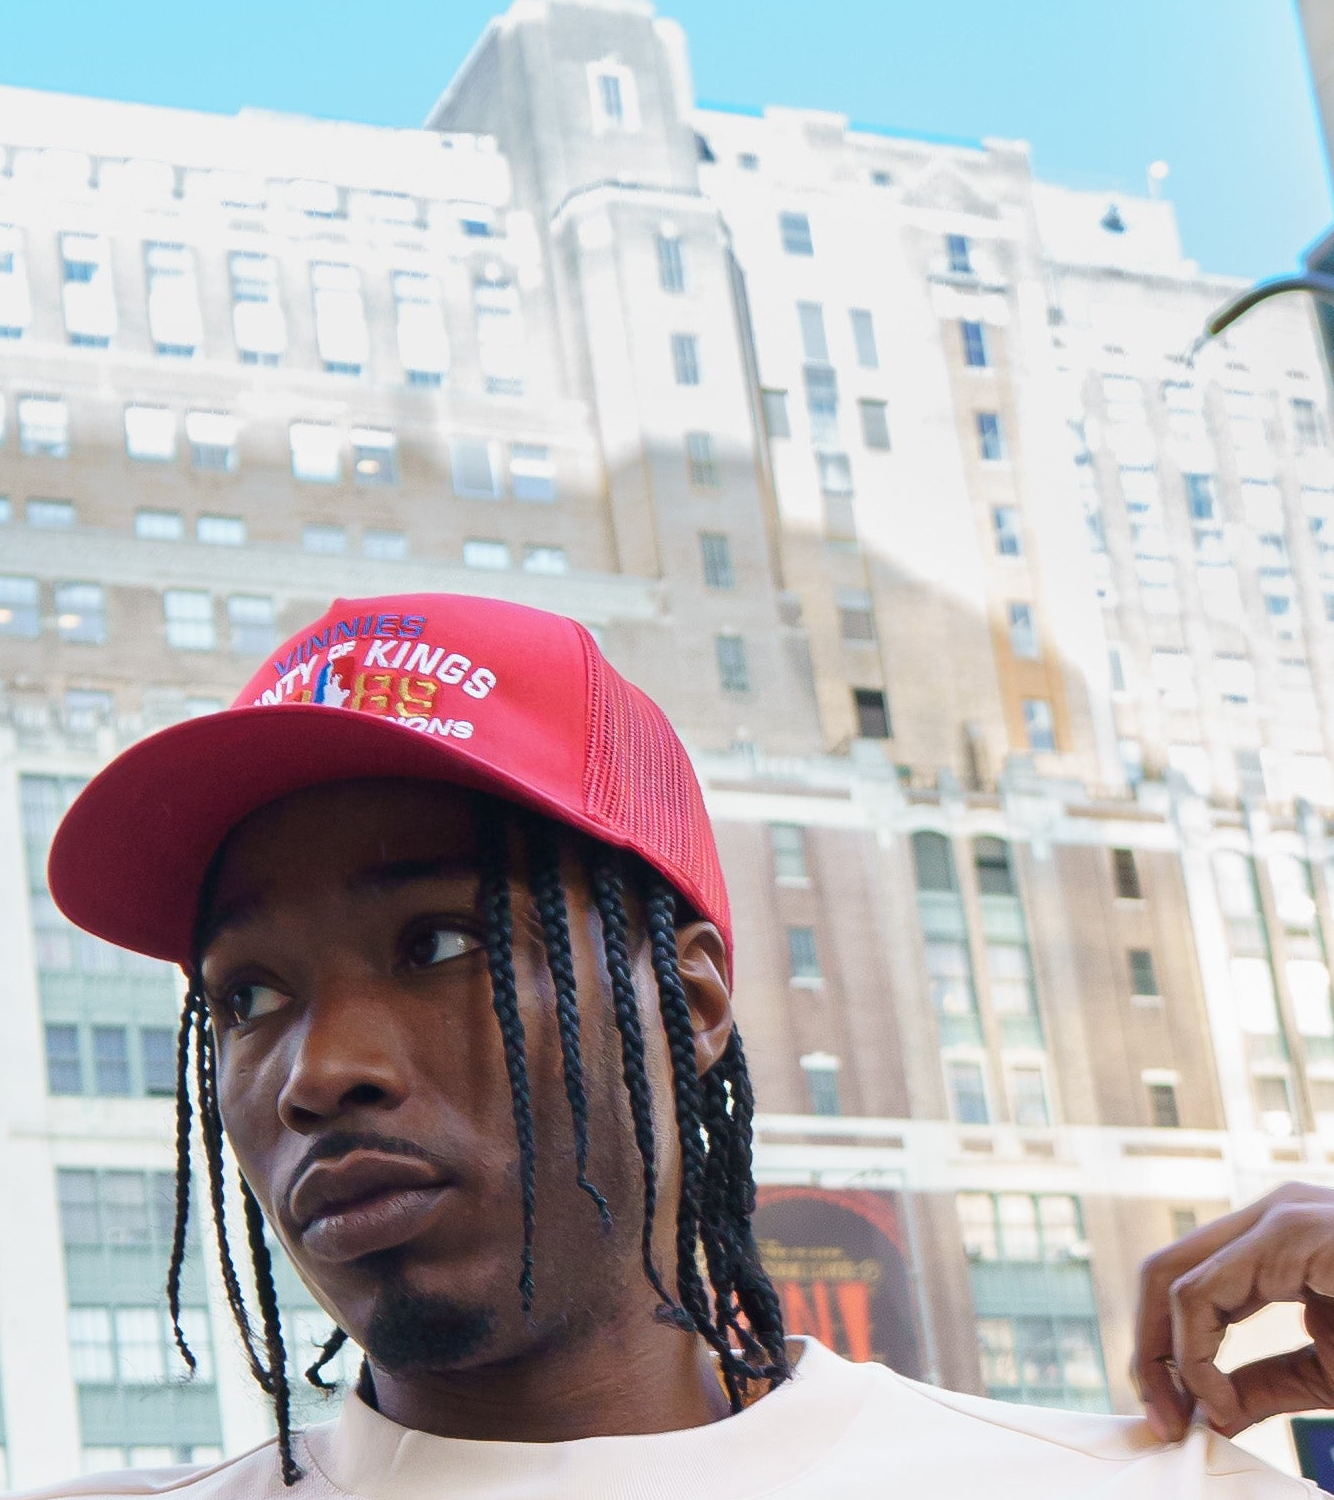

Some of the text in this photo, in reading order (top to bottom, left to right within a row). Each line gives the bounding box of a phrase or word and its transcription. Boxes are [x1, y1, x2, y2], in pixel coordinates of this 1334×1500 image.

[273, 613, 427, 676] VINNIES
[326, 640, 357, 662] OF
[363, 639, 497, 700] KINGS
